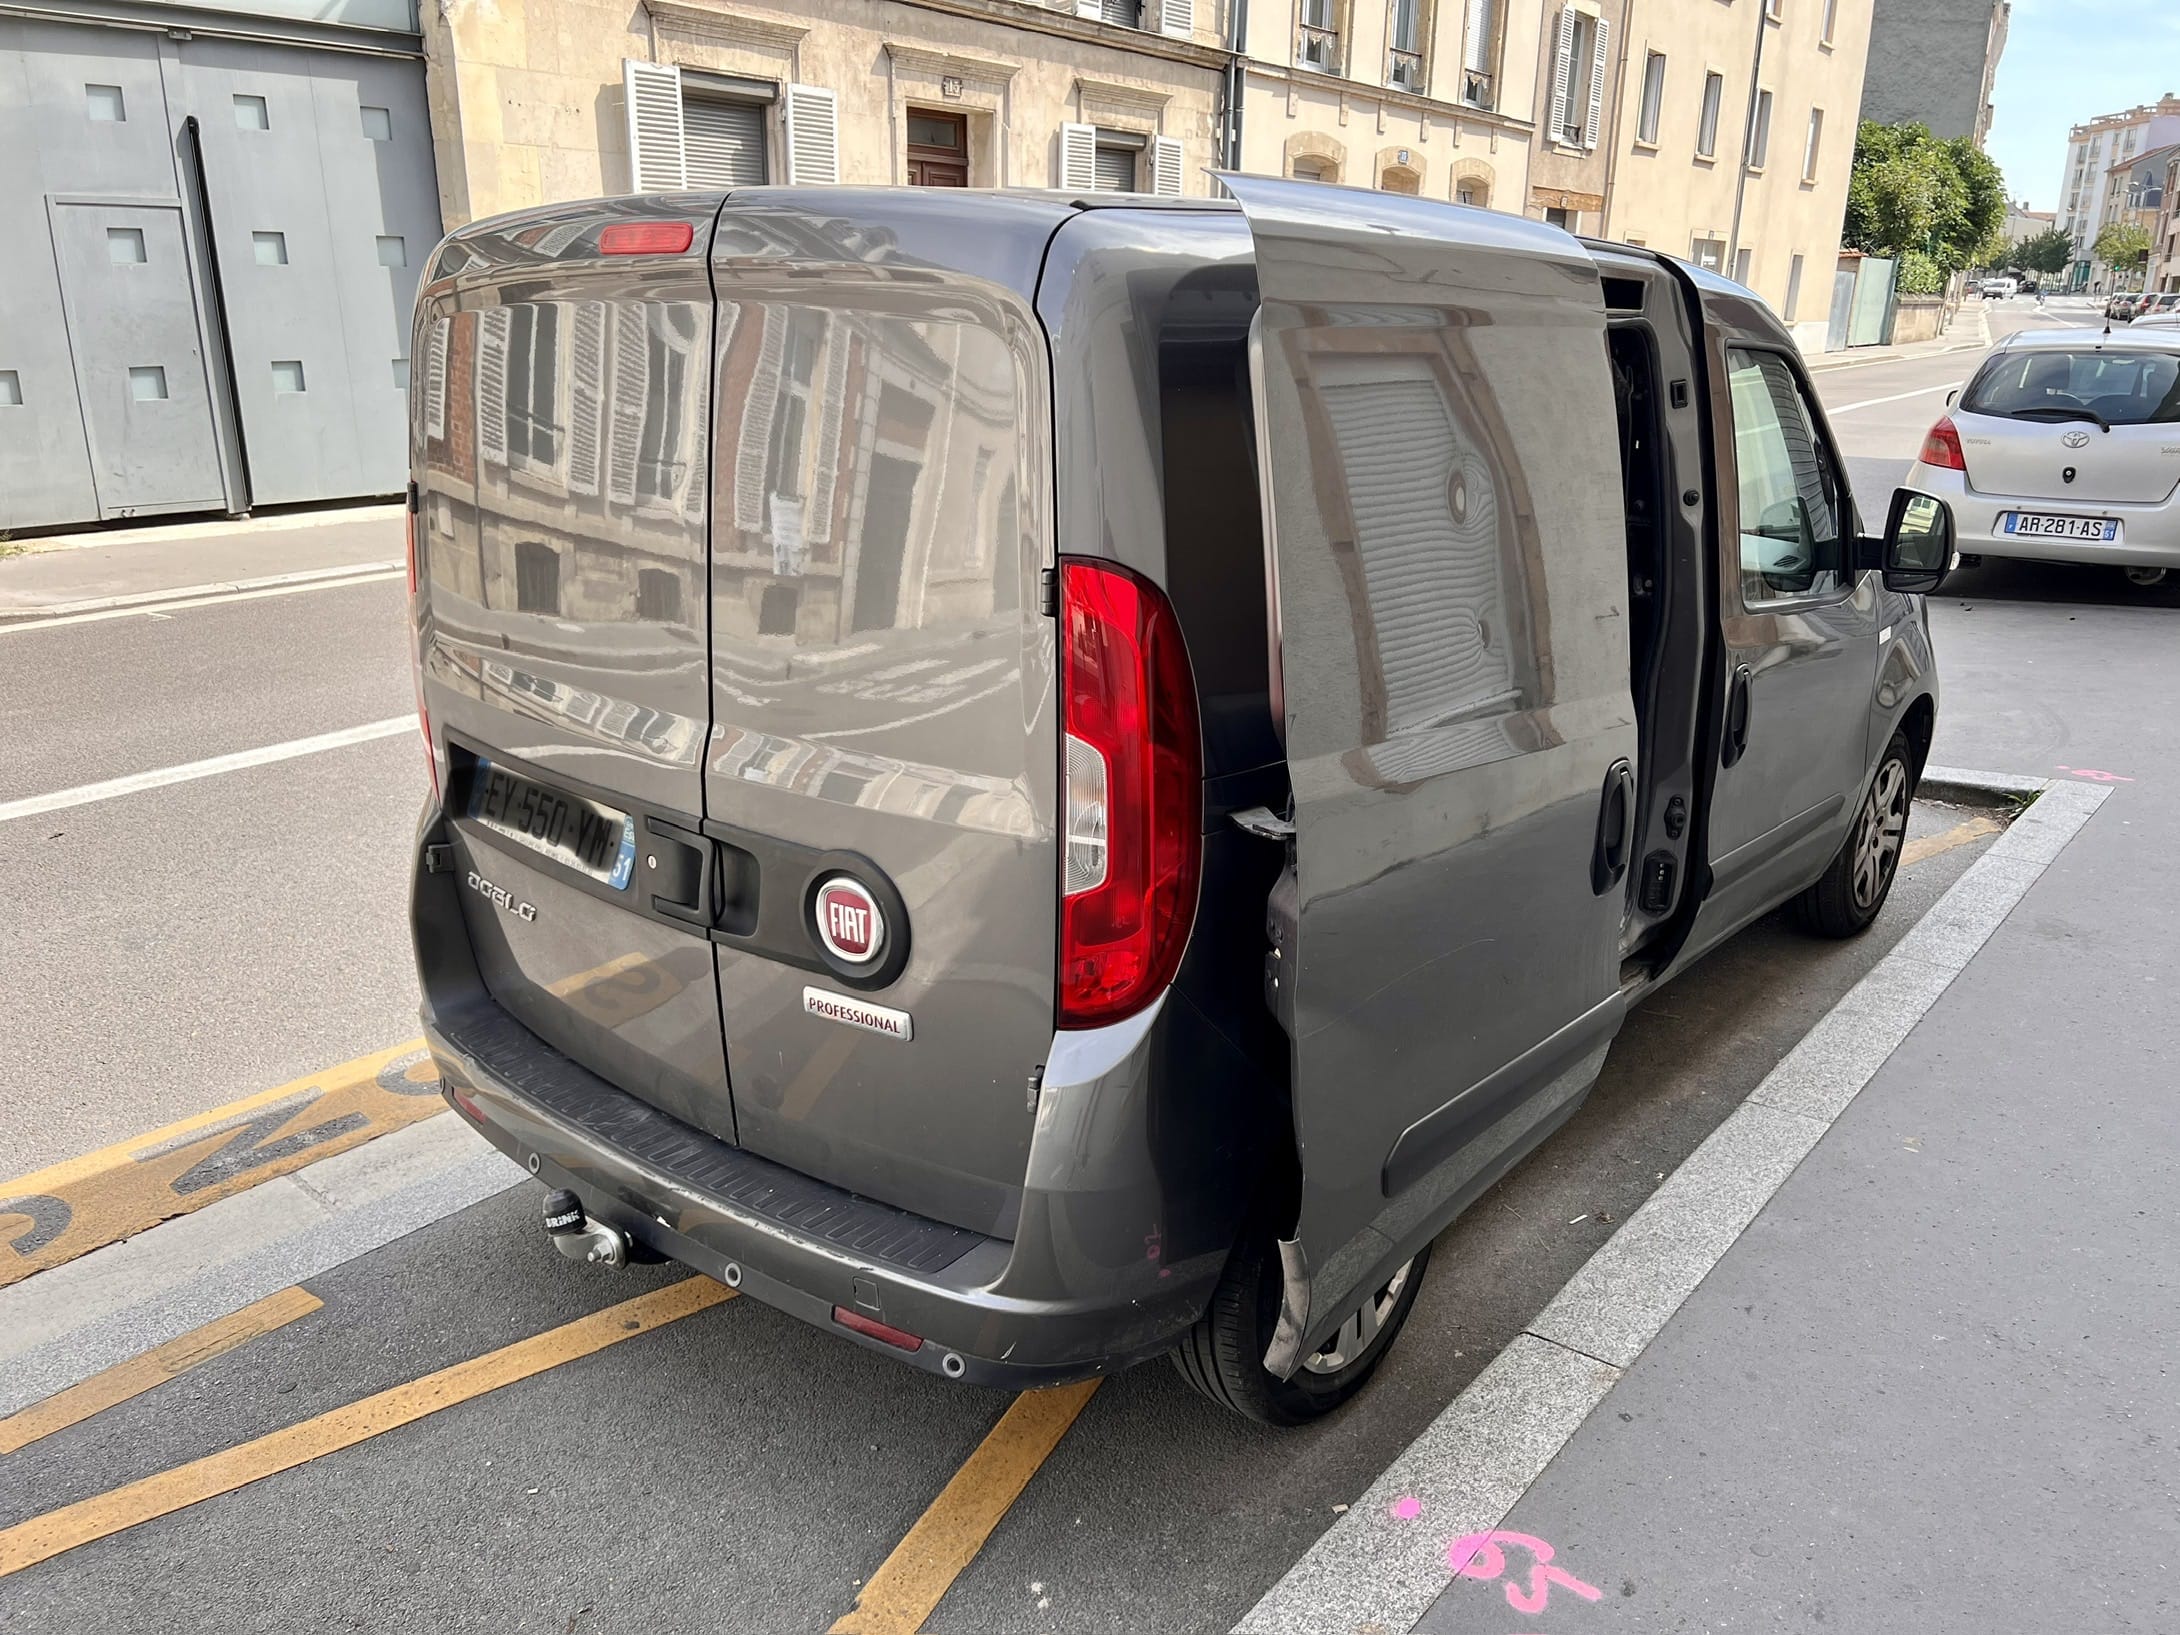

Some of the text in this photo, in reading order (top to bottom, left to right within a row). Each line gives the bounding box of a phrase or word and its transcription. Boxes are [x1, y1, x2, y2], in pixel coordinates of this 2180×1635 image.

[2018, 516, 2103, 537] AR-281-AS
[612, 854, 632, 881] 51
[829, 902, 869, 944] FIAT
[808, 996, 901, 1034] PROFESSIONAL
